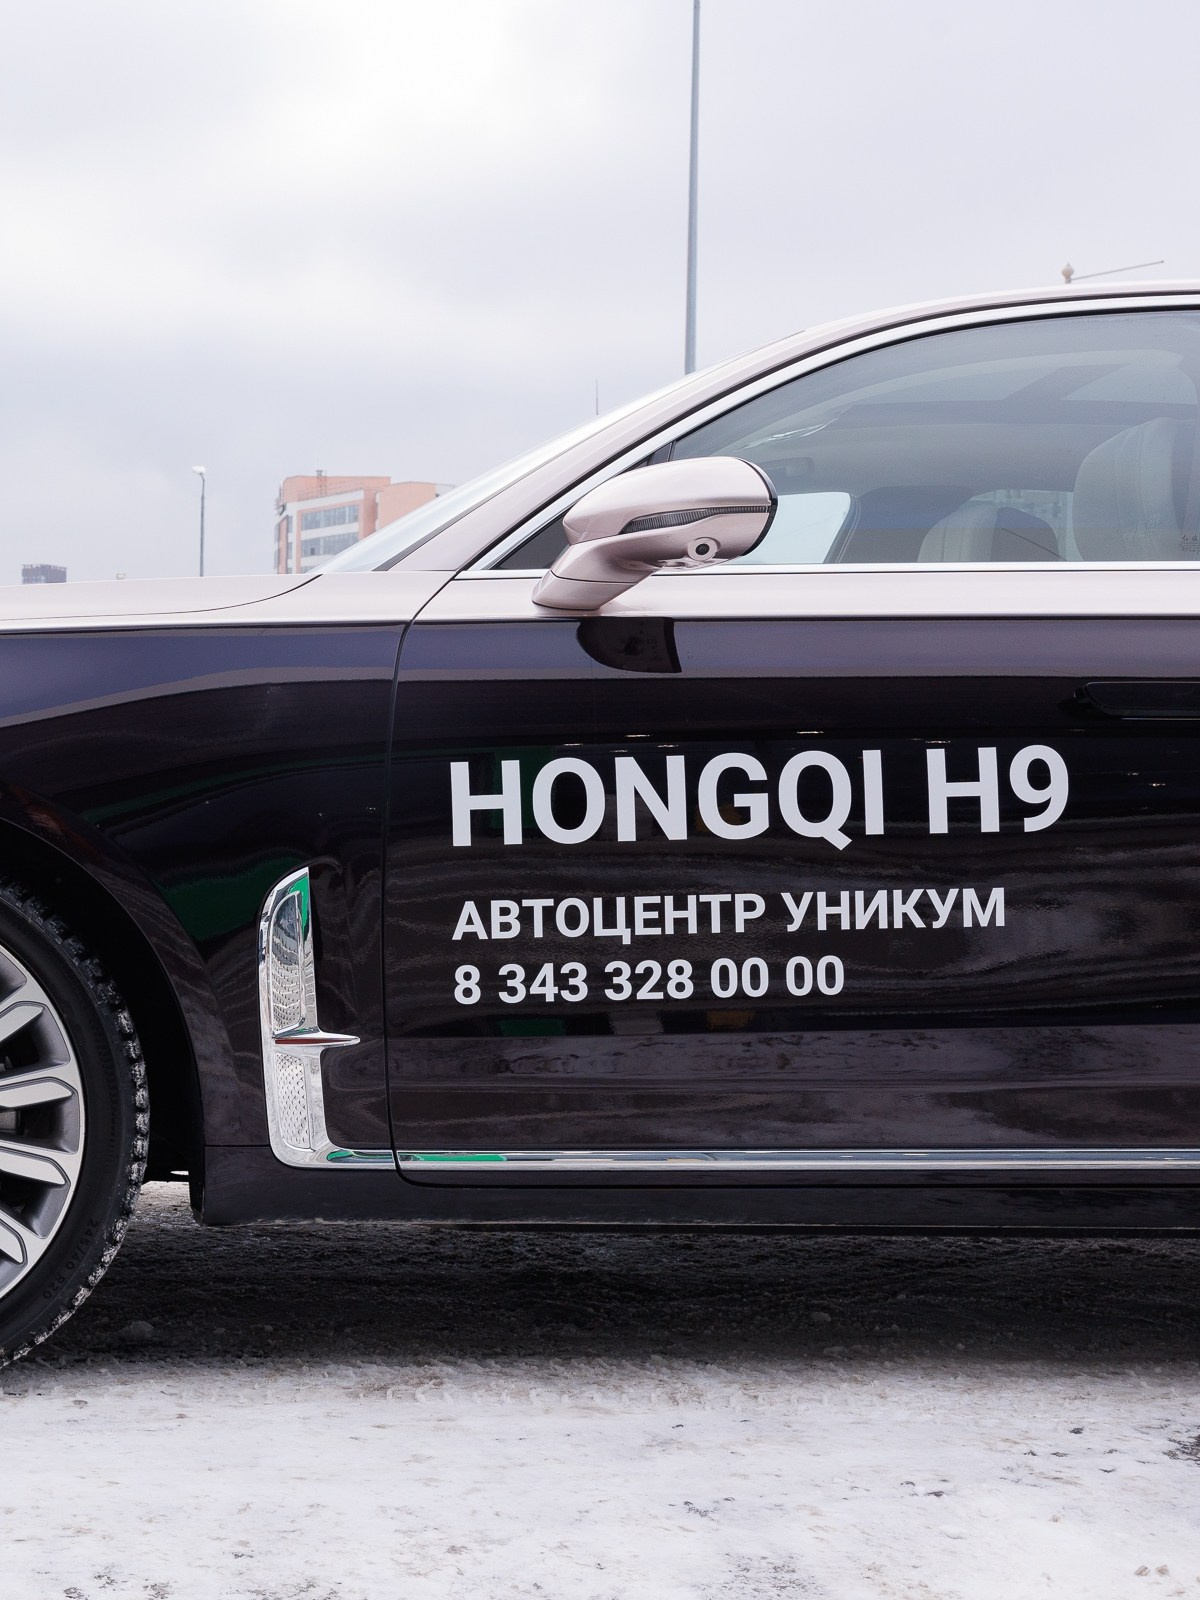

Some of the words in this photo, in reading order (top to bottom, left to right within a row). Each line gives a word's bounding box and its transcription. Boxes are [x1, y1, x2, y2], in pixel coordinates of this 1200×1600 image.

[450, 749, 885, 851] HONGQI
[926, 744, 1069, 834] H9
[452, 893, 766, 944] АВТОЦЕНТР
[781, 887, 1005, 934] УНИКУМ
[454, 964, 481, 1005] 8
[498, 962, 588, 1004] 343
[604, 959, 694, 1001] 328
[710, 957, 769, 998] 00
[785, 955, 845, 996] 00
[66, 1218, 99, 1270] 245/40
[42, 1274, 65, 1299] R20
